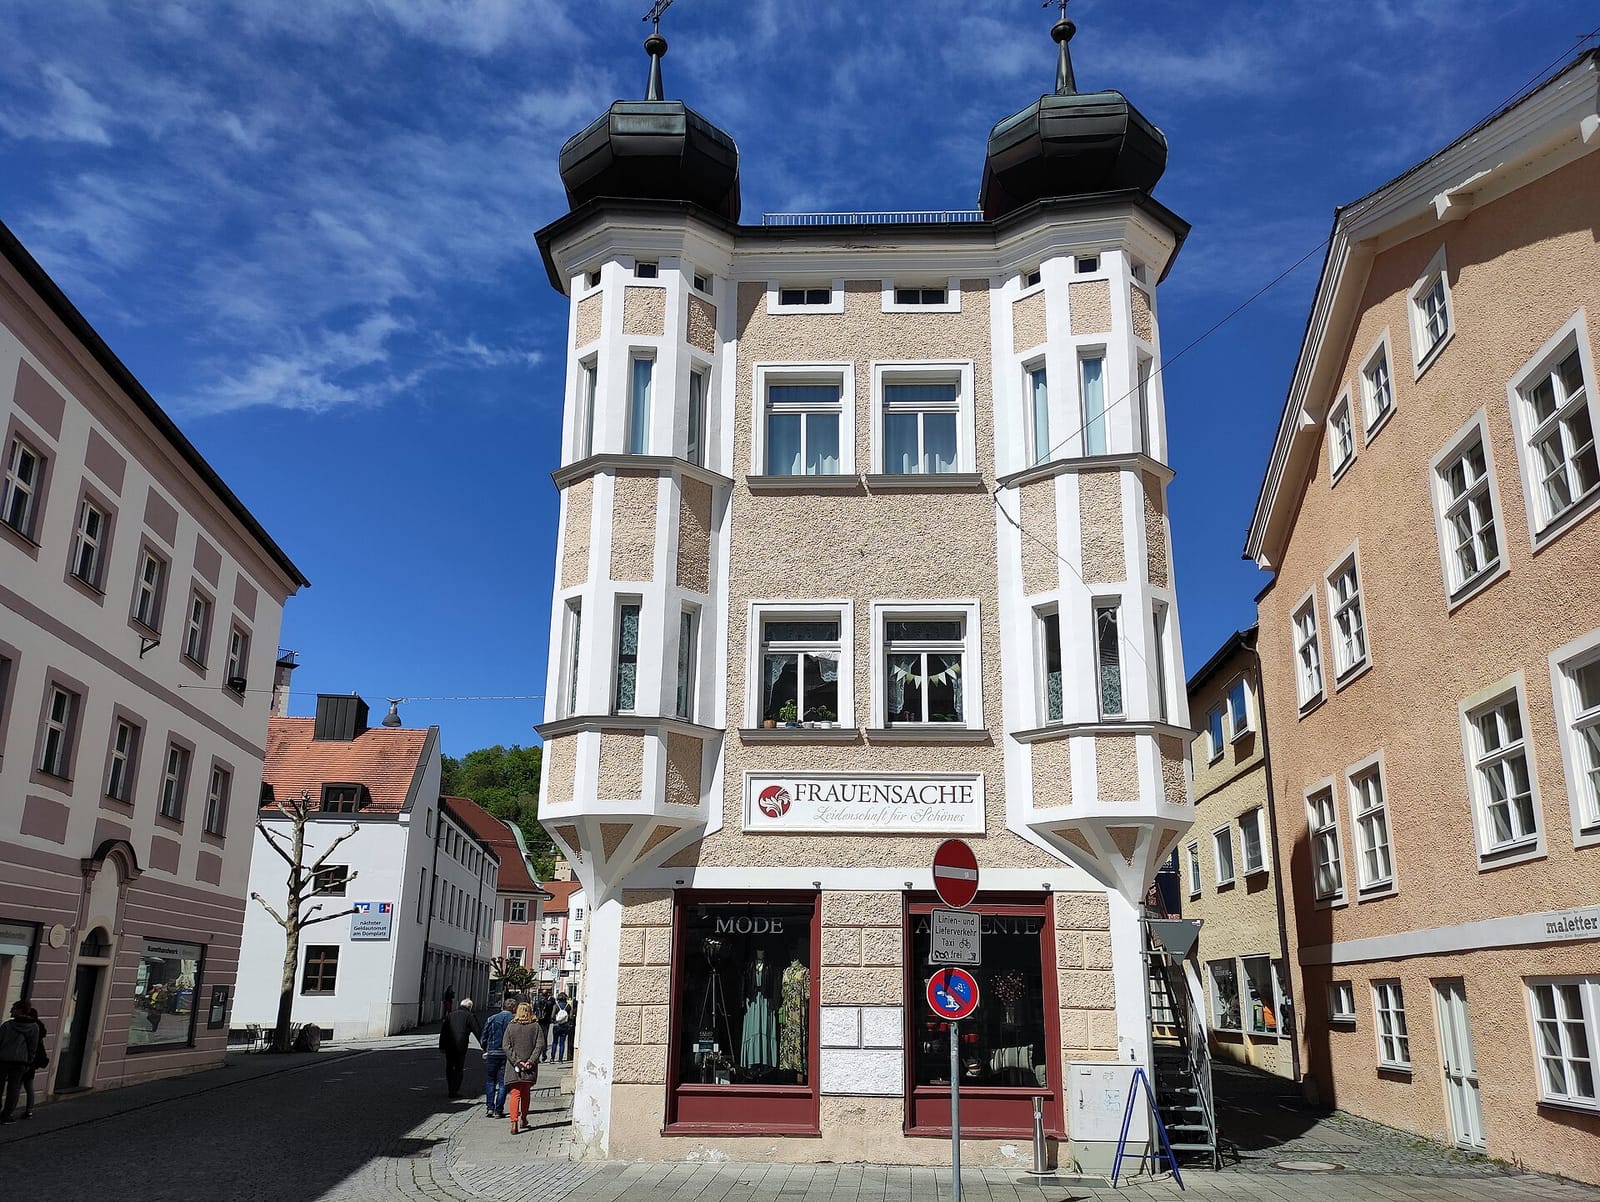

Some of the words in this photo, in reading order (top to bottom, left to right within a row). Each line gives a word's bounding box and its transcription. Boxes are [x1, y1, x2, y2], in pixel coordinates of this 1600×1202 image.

[794, 783, 974, 804] FRAUENSACHE
[814, 806, 887, 825] Leidenschaft
[886, 807, 907, 824] für
[910, 806, 965, 823] Schönes
[714, 916, 784, 934] MODE
[915, 917, 1039, 935] AENTE
[938, 914, 960, 925] Linien-
[962, 917, 975, 926] und
[1546, 915, 1598, 933] maletter
[935, 926, 977, 937] Lieferverkehr
[941, 937, 955, 947] Taxi
[950, 949, 962, 959] frei
